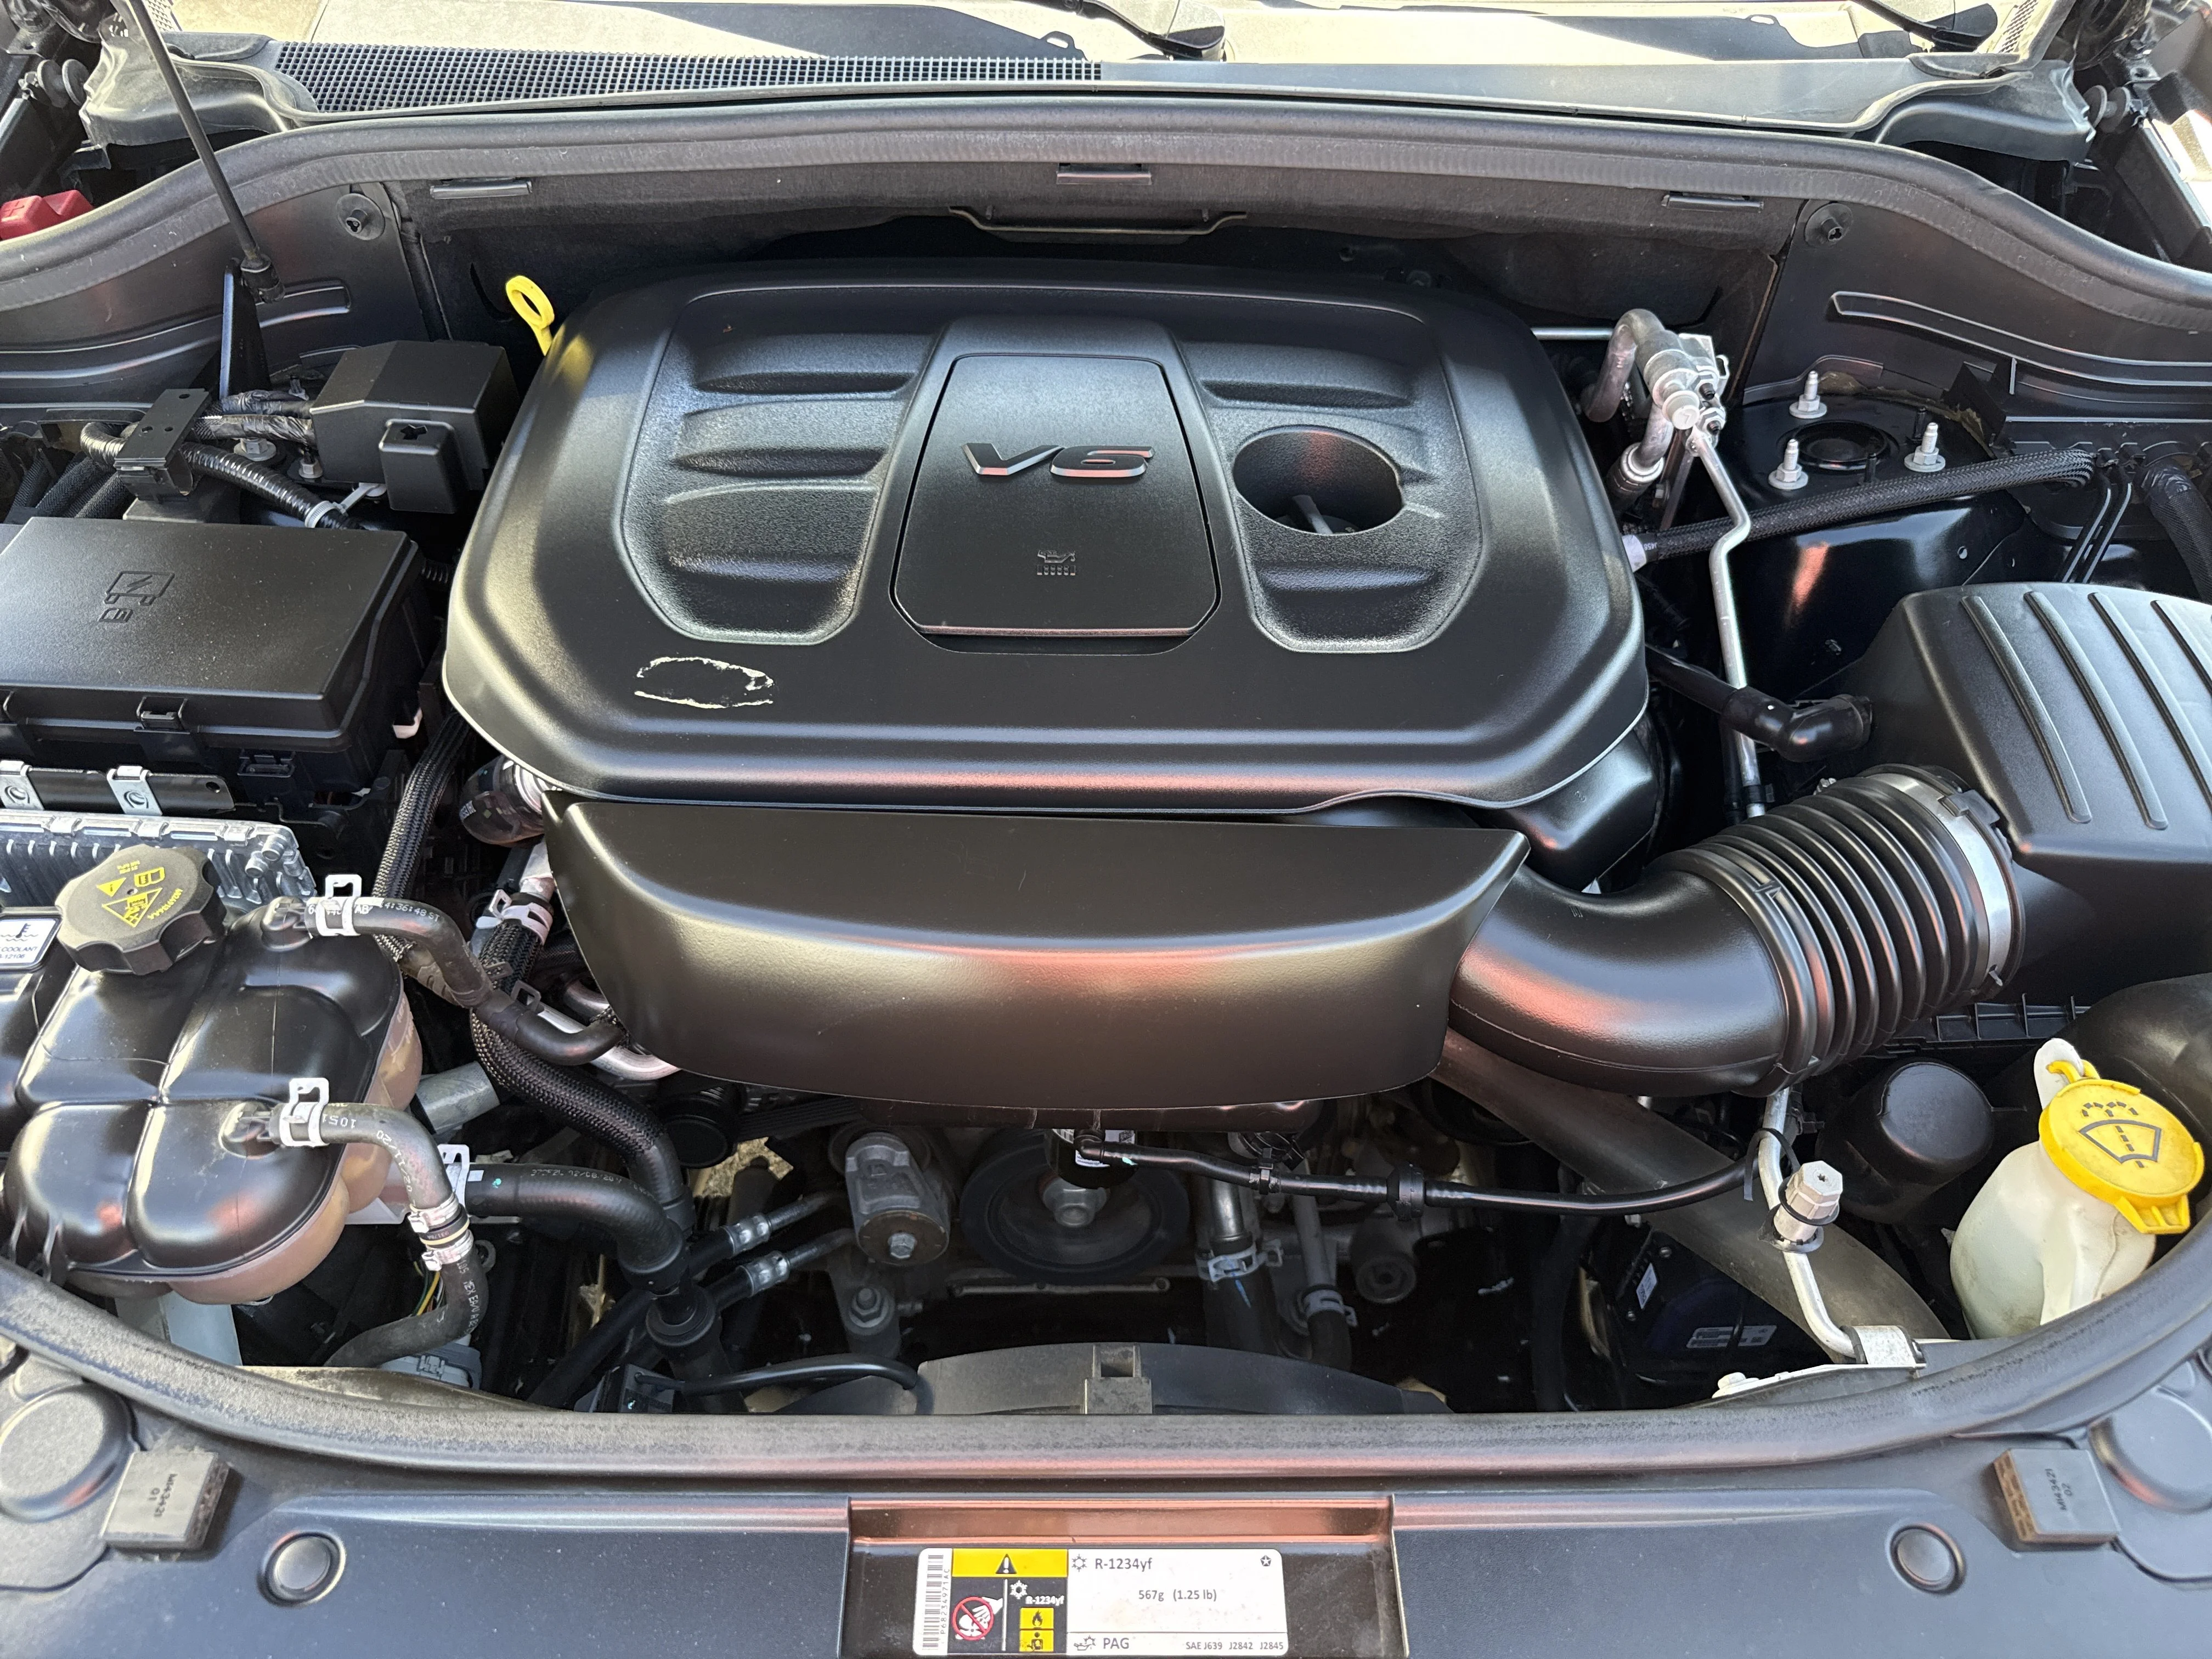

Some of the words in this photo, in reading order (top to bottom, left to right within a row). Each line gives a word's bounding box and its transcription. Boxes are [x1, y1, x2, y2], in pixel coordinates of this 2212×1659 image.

[962, 442, 1155, 478] V6
[428, 912, 441, 923] ST
[1094, 1557, 1153, 1572] R-1234yf
[940, 1568, 950, 1635] P68234971AC
[1025, 1595, 1065, 1606] R-1234yf
[1138, 1590, 1165, 1602] 567g
[1173, 1589, 1200, 1601] (1.25
[1203, 1589, 1217, 1601] lb)
[1103, 1638, 1130, 1650] PAG
[1186, 1642, 1202, 1650] SAE
[1203, 1642, 1223, 1650] J639
[1229, 1642, 1254, 1650] J2842
[1260, 1642, 1284, 1650] J2845
